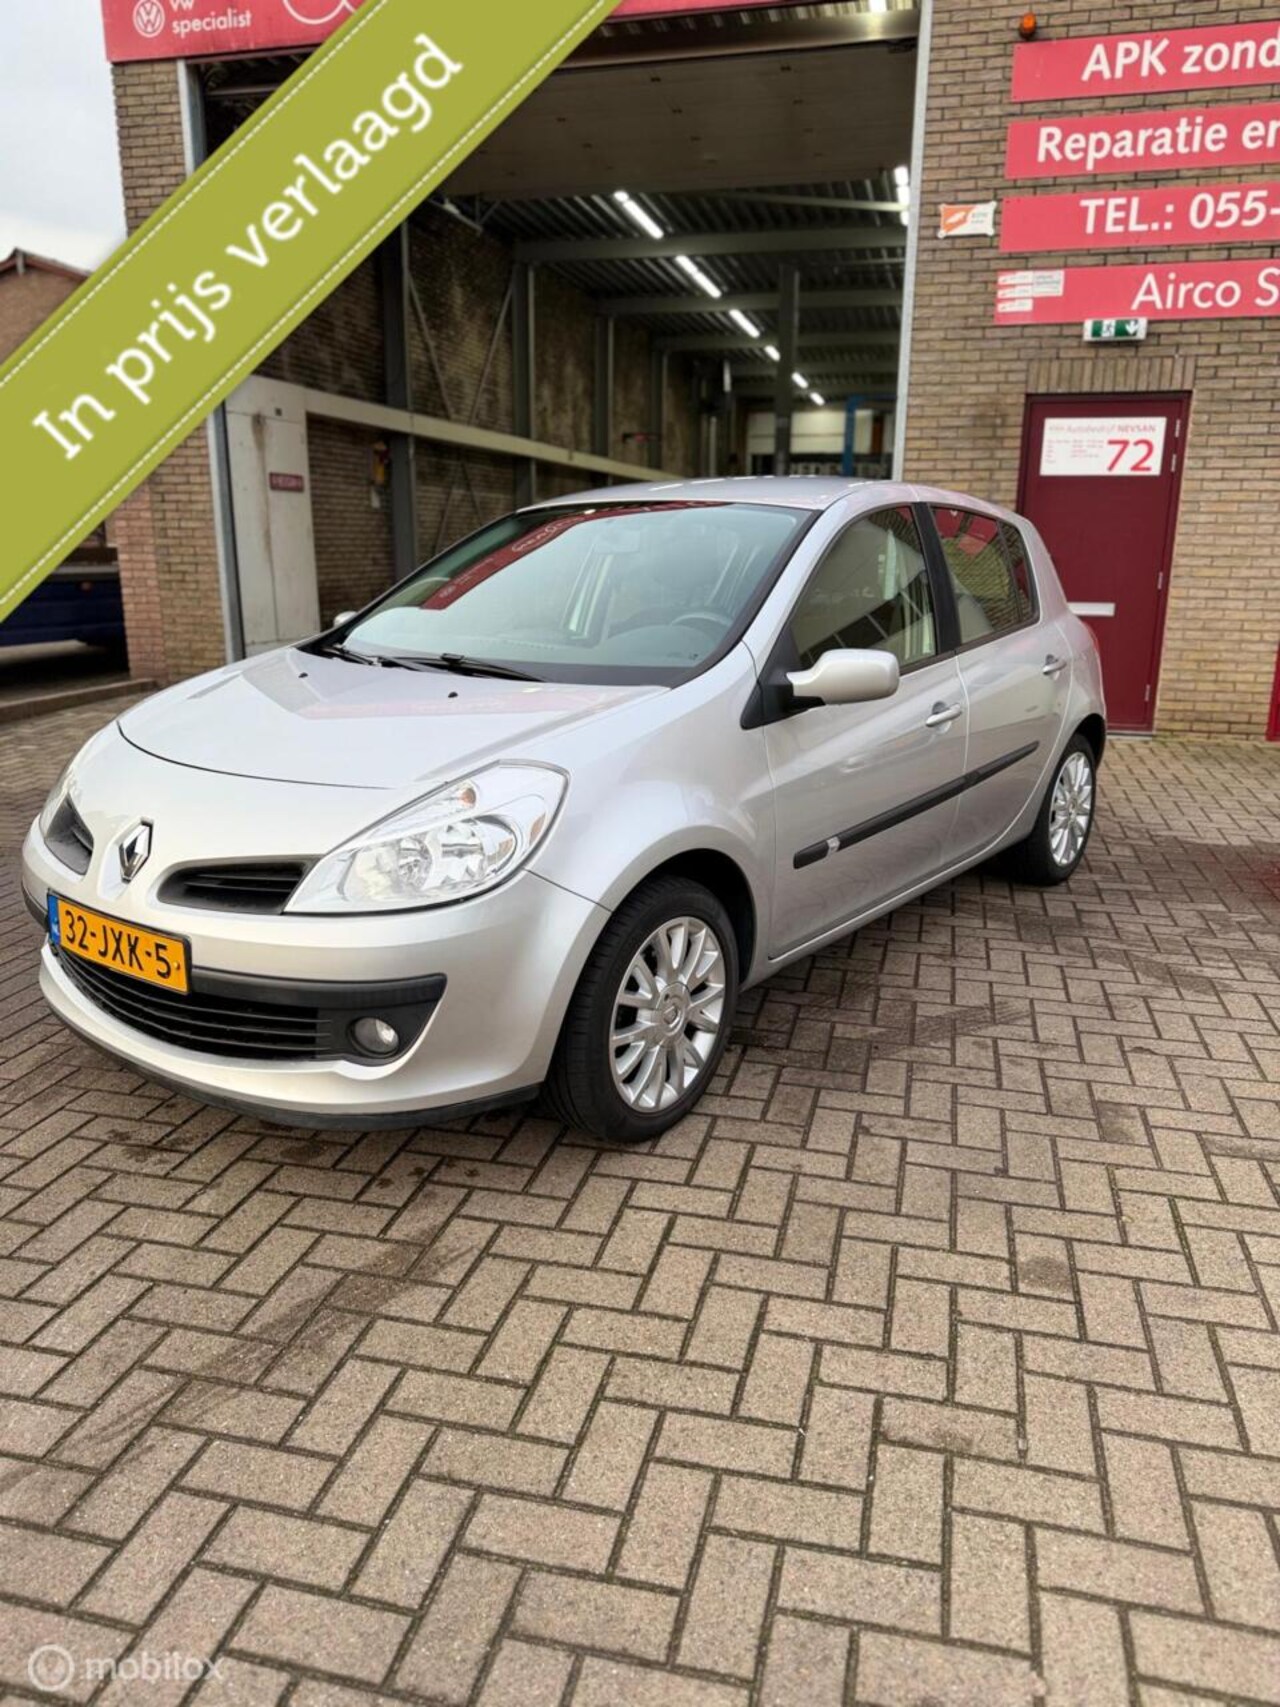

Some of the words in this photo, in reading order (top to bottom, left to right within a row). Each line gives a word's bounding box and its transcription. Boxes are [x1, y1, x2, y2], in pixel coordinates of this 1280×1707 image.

[172, 8, 252, 39] specialist
[1081, 38, 1171, 82] APK
[1181, 26, 1280, 74] zond
[1038, 115, 1229, 171] Reparatie
[1079, 196, 1174, 234] TEL.:
[1130, 272, 1242, 311] Airco
[1254, 266, 1280, 307] S
[1107, 438, 1155, 472] 72
[64, 909, 172, 980] 32-JXK-5
